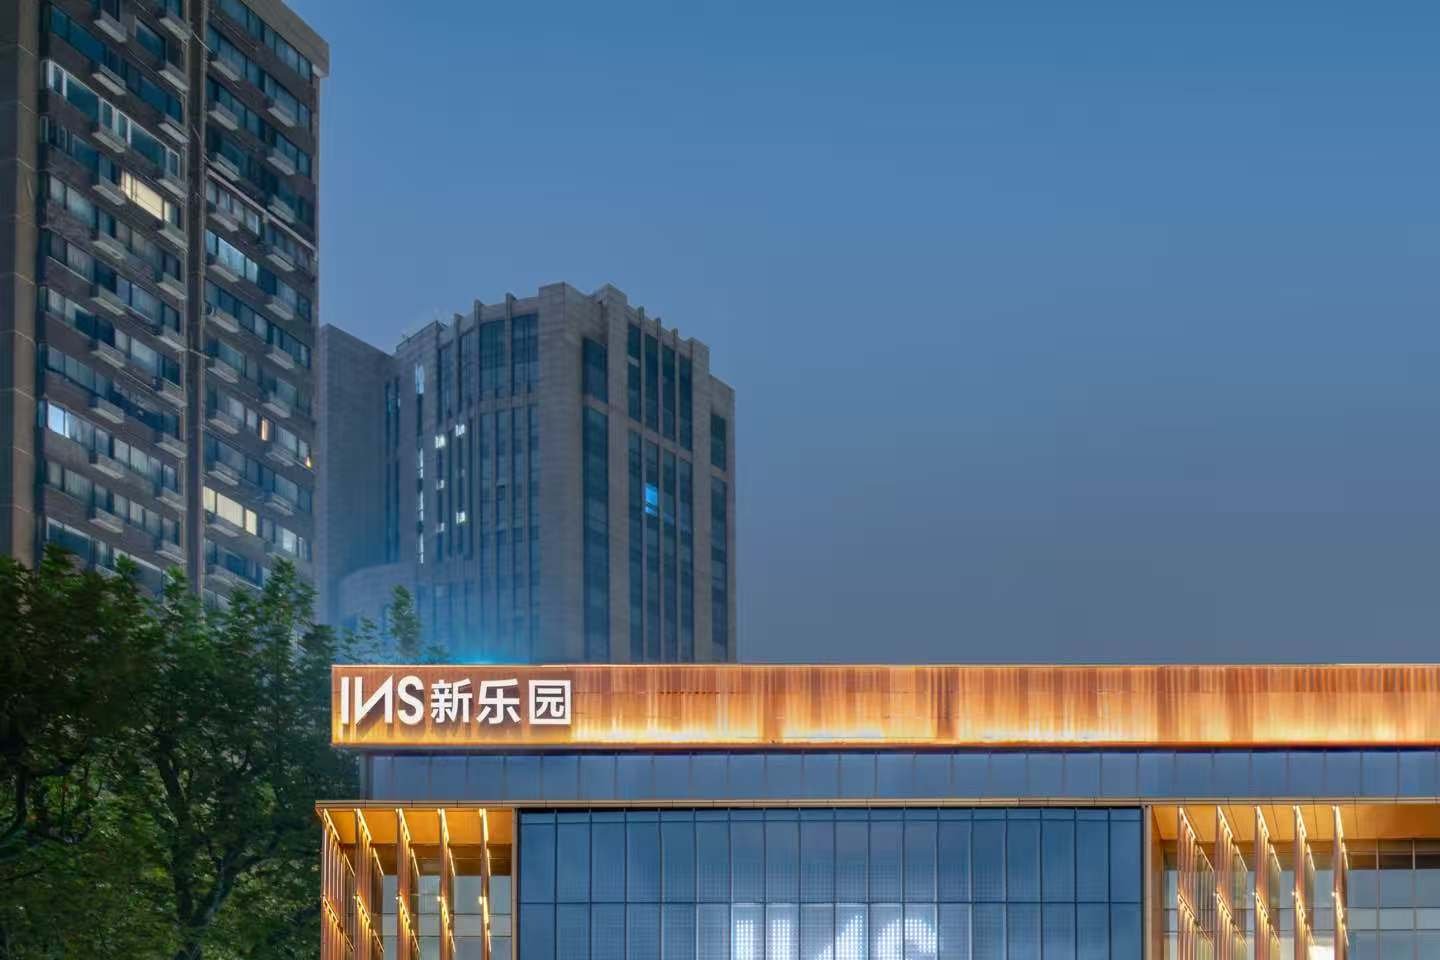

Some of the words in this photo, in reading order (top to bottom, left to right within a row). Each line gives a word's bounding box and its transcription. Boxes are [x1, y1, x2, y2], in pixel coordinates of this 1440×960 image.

[341, 674, 425, 726] INS
[430, 678, 572, 726] 新乐园
